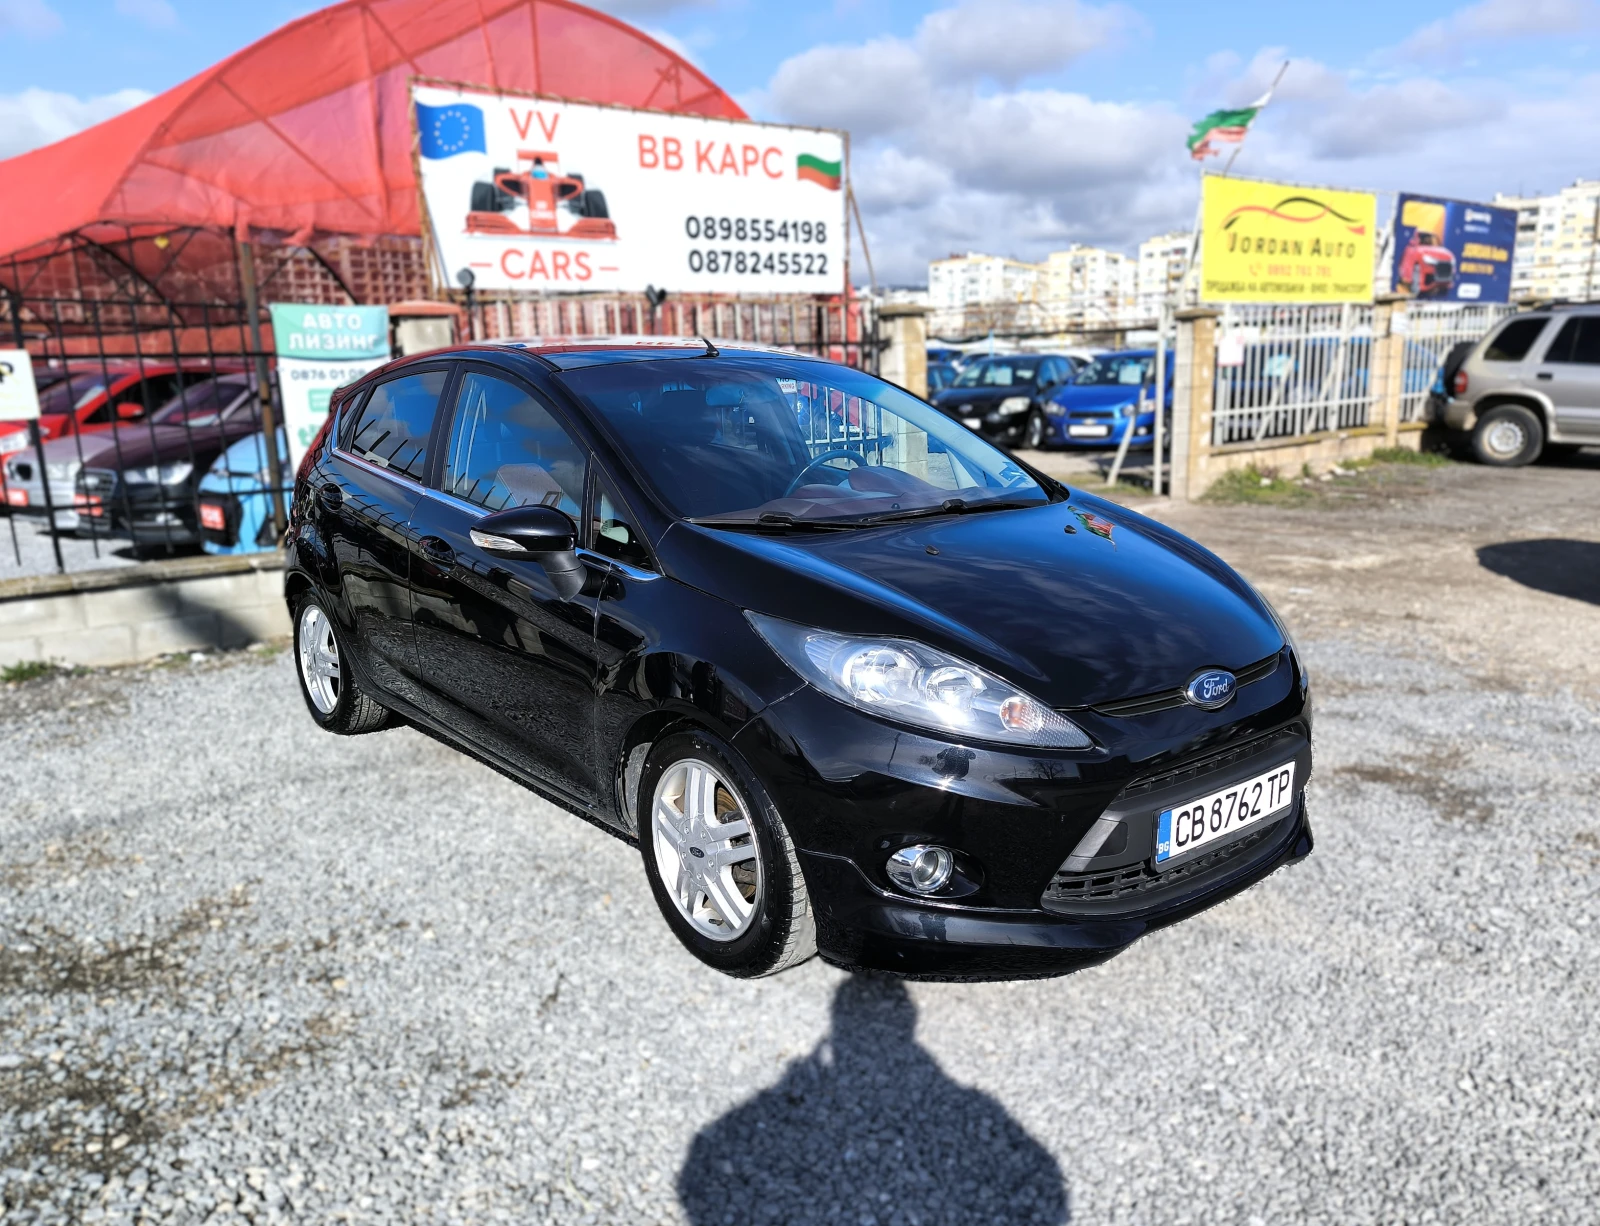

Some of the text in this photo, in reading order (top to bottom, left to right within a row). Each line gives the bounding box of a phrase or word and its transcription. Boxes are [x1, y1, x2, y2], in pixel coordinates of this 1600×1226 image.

[509, 107, 559, 143] VV
[638, 133, 784, 179] ВВ КАРС
[685, 214, 827, 244] 0898554198
[500, 247, 593, 282] CARS
[688, 249, 829, 275] 0878245522
[302, 312, 363, 330] АВТО
[288, 333, 379, 350] ЛИЗИНГ
[1203, 676, 1230, 698] Ford
[1176, 769, 1290, 848] CB 8762 TP
[1158, 841, 1169, 853] BG
